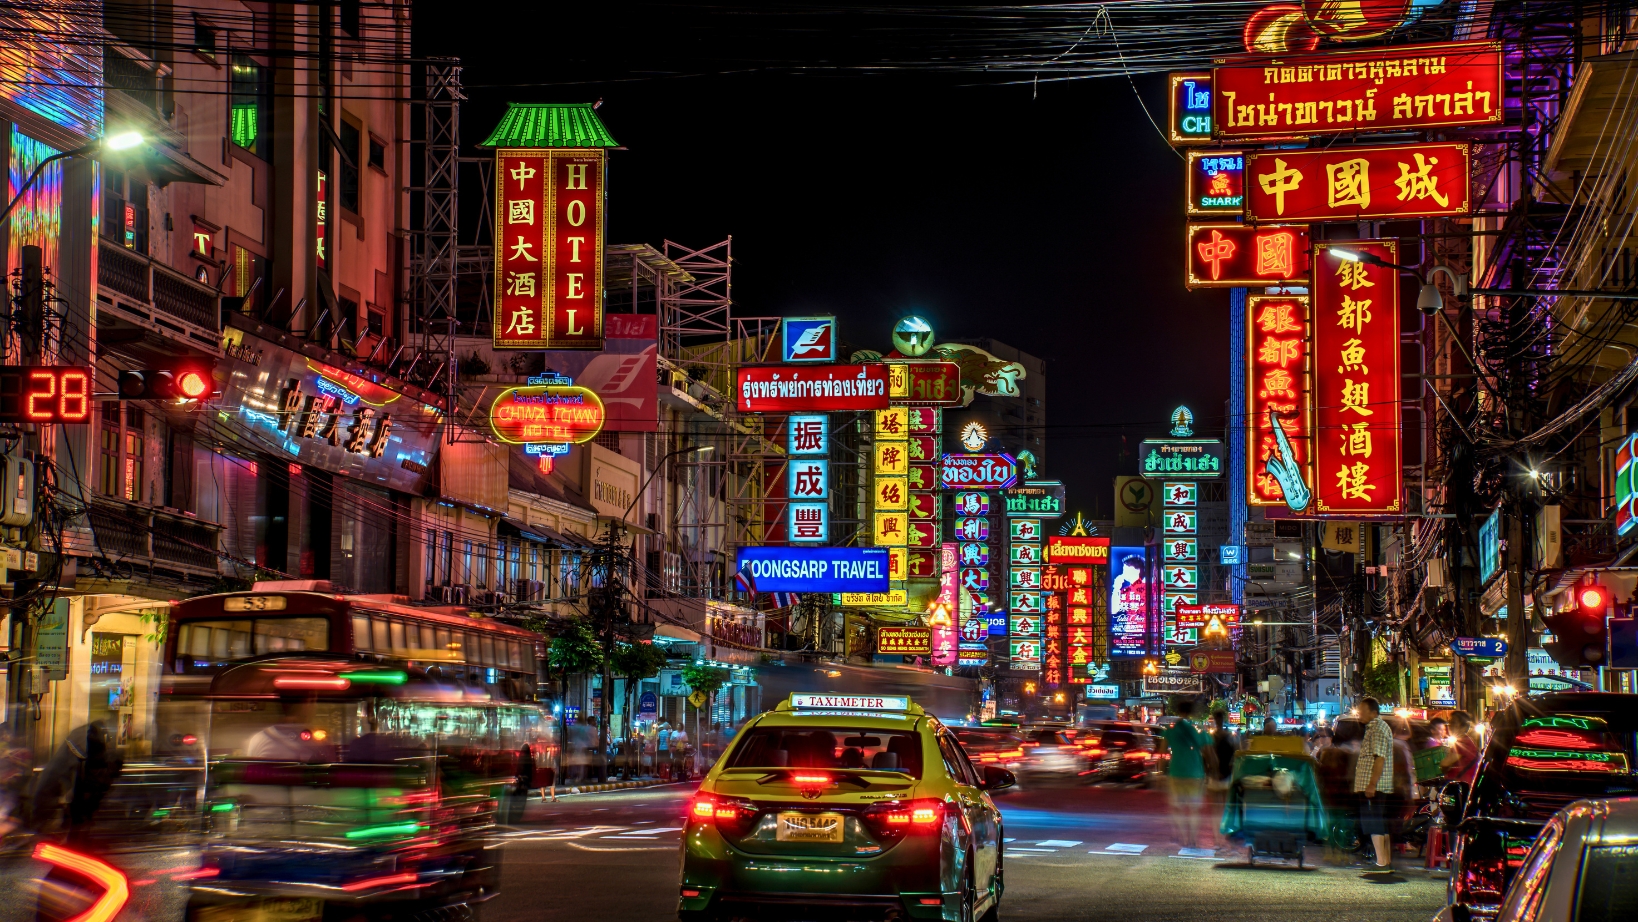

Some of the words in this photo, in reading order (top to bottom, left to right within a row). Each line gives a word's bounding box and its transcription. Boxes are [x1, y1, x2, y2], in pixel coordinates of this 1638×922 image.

[1222, 88, 1378, 127] ไชน่าทาวน์
[1393, 81, 1491, 120] สกาล่า
[1258, 153, 1449, 216] 中國城
[506, 162, 538, 336] 中國大酒店
[565, 163, 588, 336] HOTEL
[1198, 230, 1293, 279] 中國
[28, 372, 88, 418] 28
[742, 366, 885, 408] รุ่งทรัพย์การท่องเที่ยว
[1334, 256, 1377, 503] 銀都魚翅酒樓
[499, 405, 547, 421] CHINA
[554, 406, 599, 423] TOWN
[523, 425, 572, 437] HOTEL
[832, 560, 884, 579] TRAVEL
[243, 596, 267, 611] 53
[1495, 642, 1503, 652] 2
